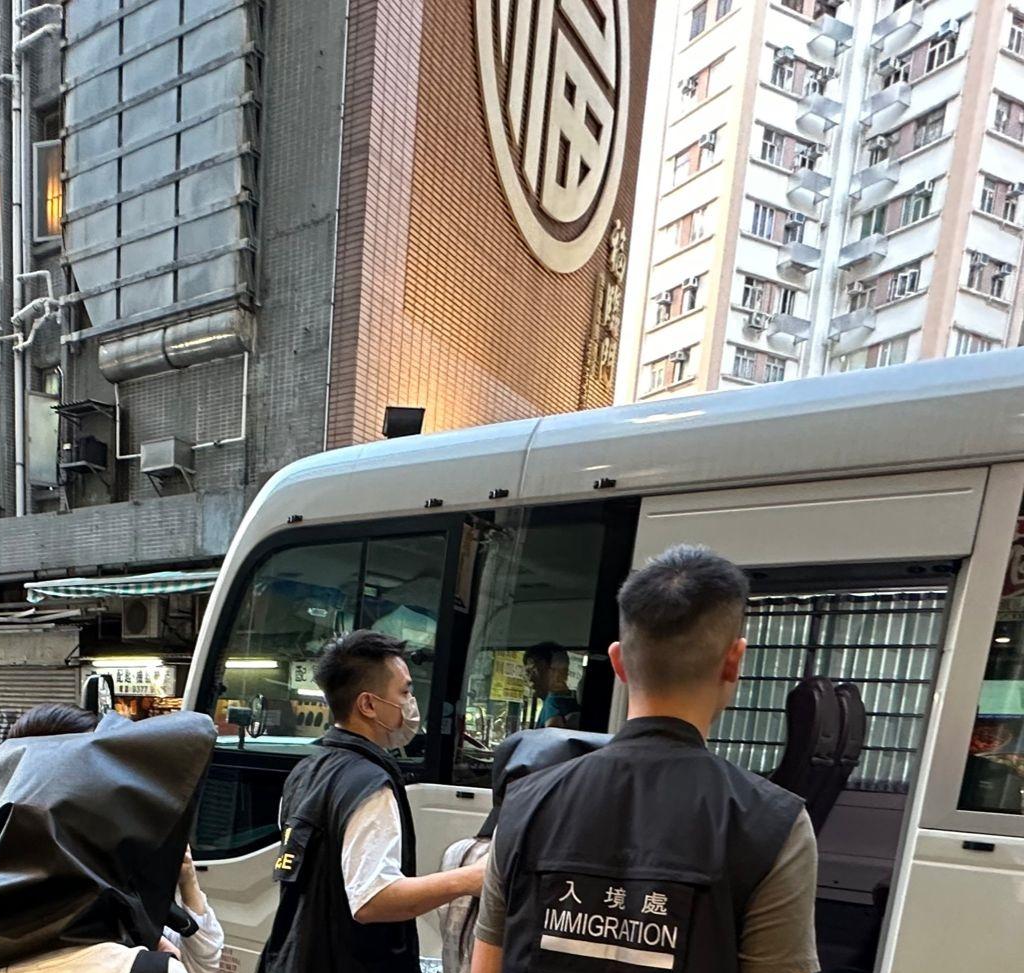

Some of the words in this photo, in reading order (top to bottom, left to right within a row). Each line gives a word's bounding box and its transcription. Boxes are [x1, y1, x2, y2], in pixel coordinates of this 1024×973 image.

[558, 880, 668, 916] 入境處
[543, 908, 678, 949] IMMIGRATION
